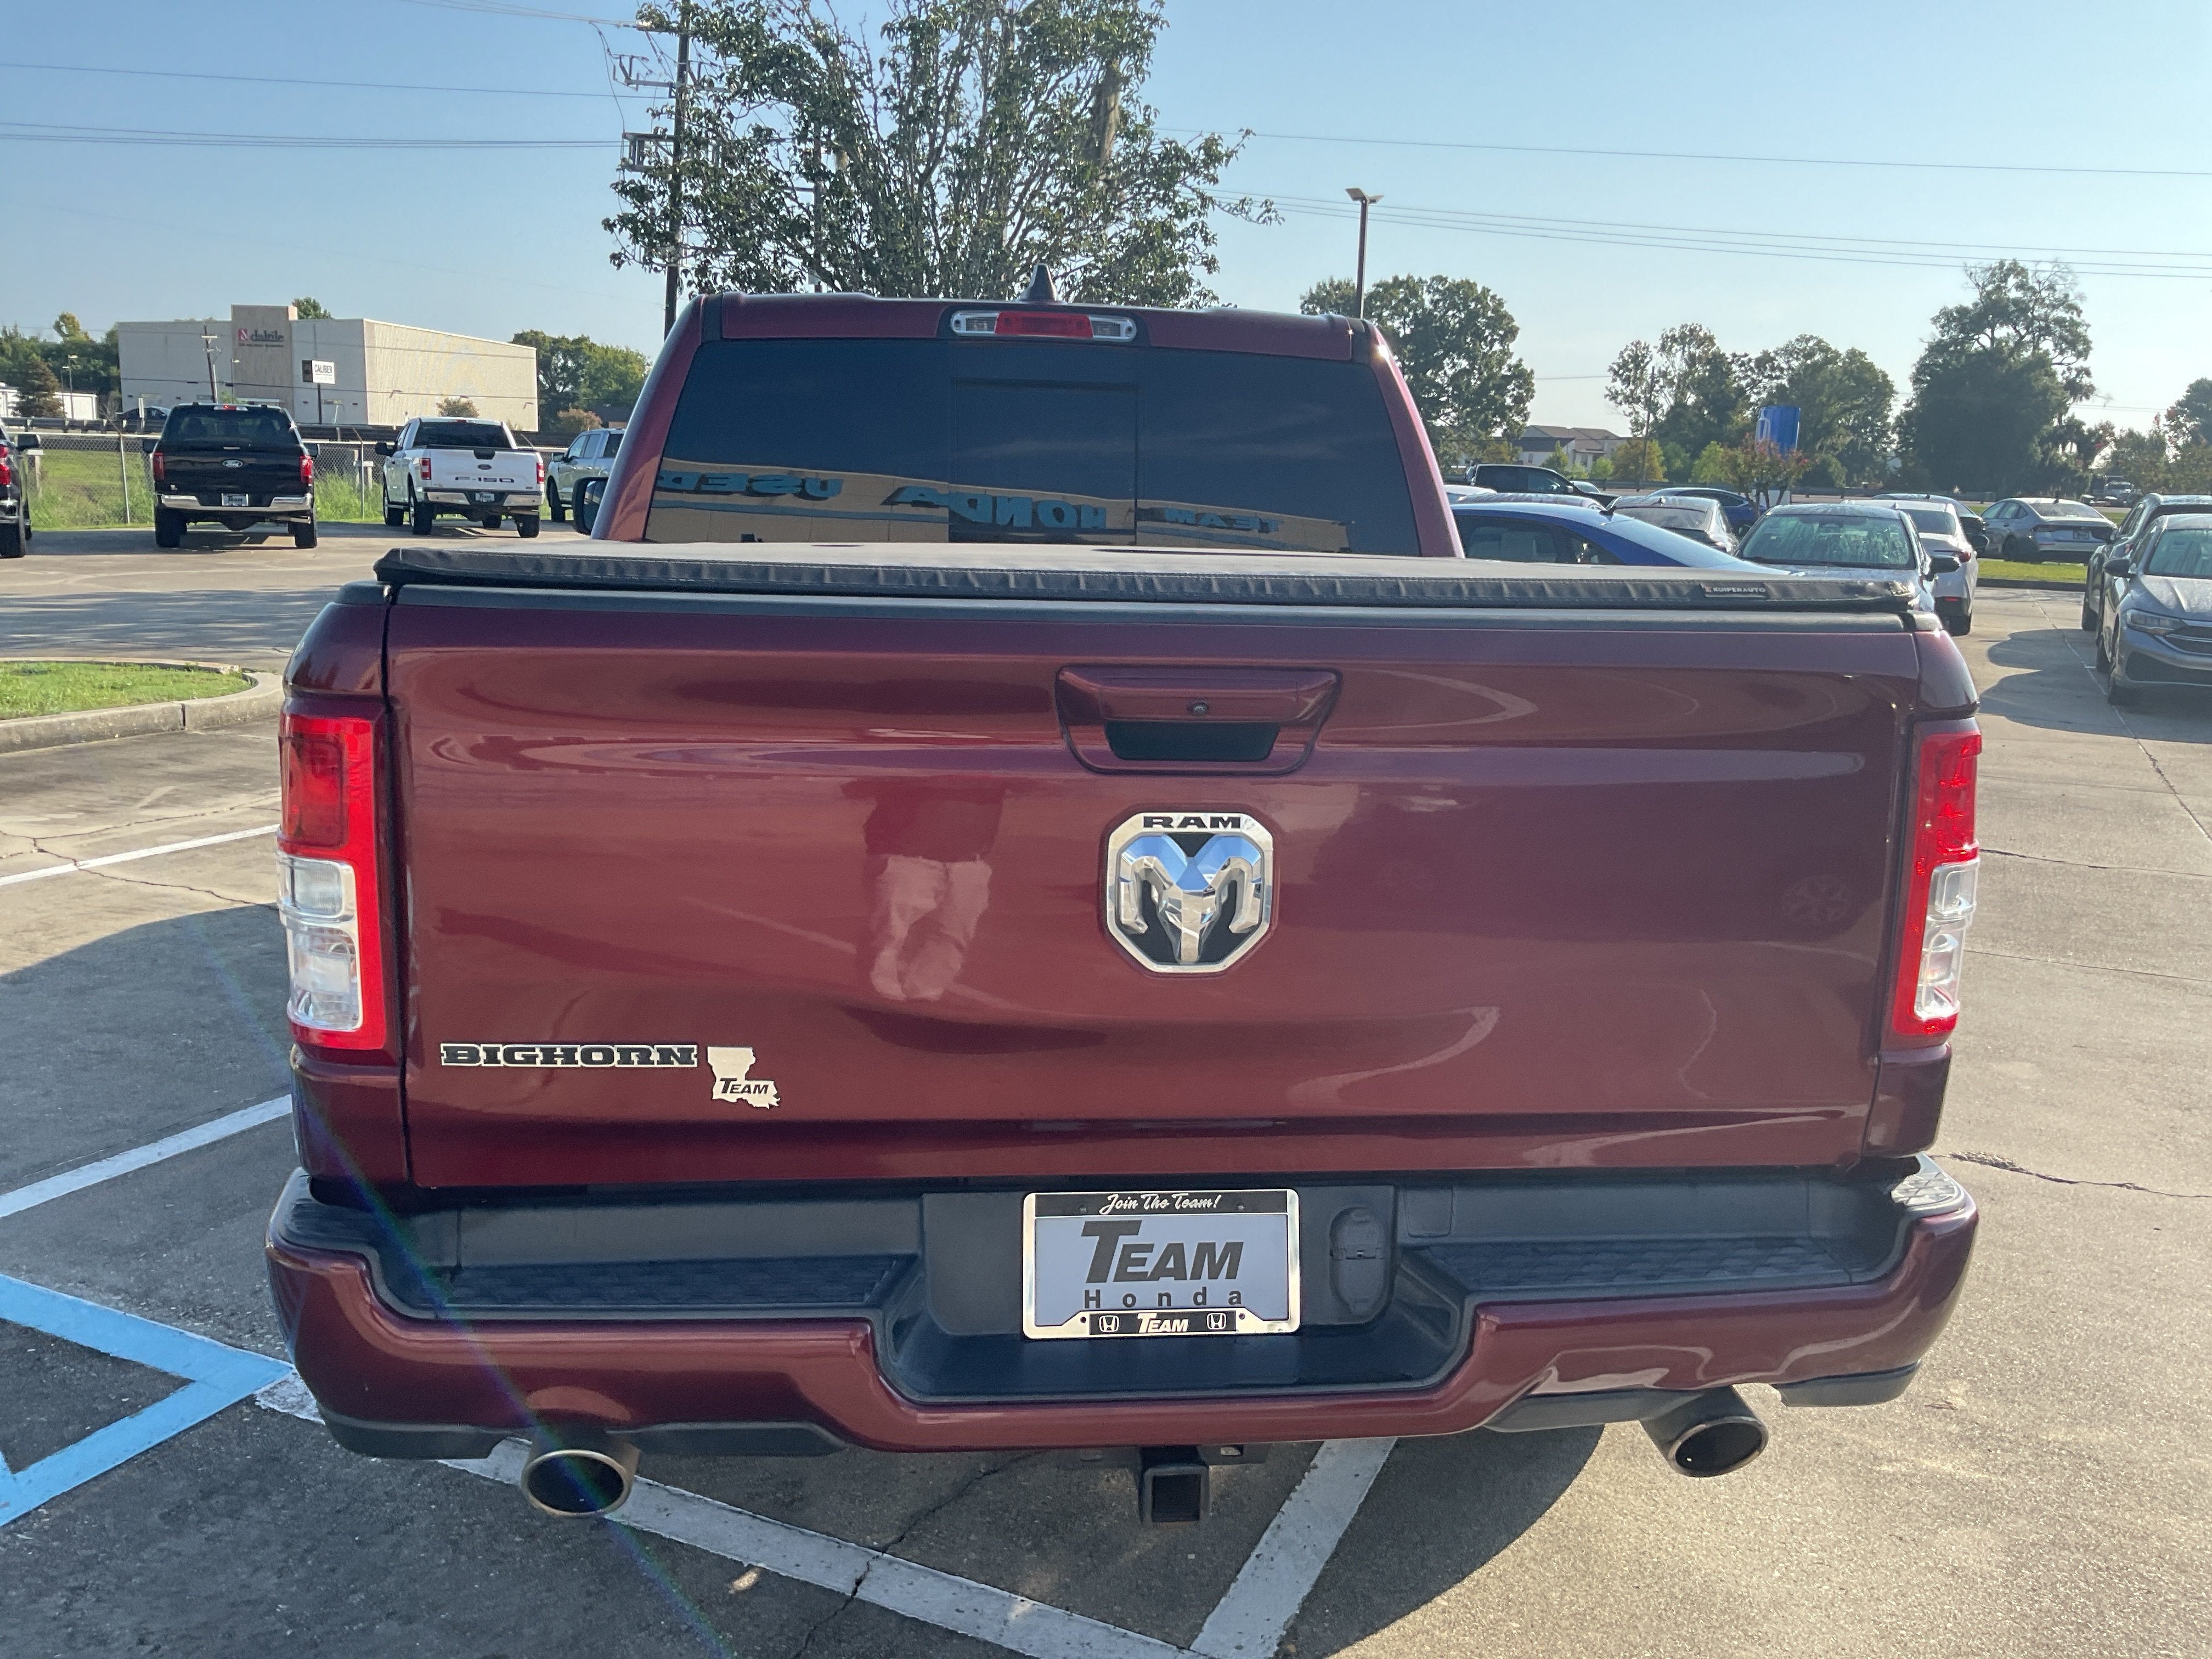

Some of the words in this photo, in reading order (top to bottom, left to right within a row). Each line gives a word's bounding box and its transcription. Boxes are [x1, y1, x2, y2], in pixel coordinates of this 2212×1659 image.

[314, 364, 332, 374] CALIBER
[1143, 816, 1241, 829] RAM
[440, 1043, 697, 1067] BIGHORN
[719, 1078, 769, 1094] TEAM
[1099, 1194, 1138, 1214] Join
[1140, 1194, 1173, 1210] The
[1173, 1193, 1222, 1210] Team!
[1081, 1220, 1244, 1283] TEAM
[1084, 1287, 1242, 1308] Honda
[1137, 1313, 1189, 1333] TEAM
